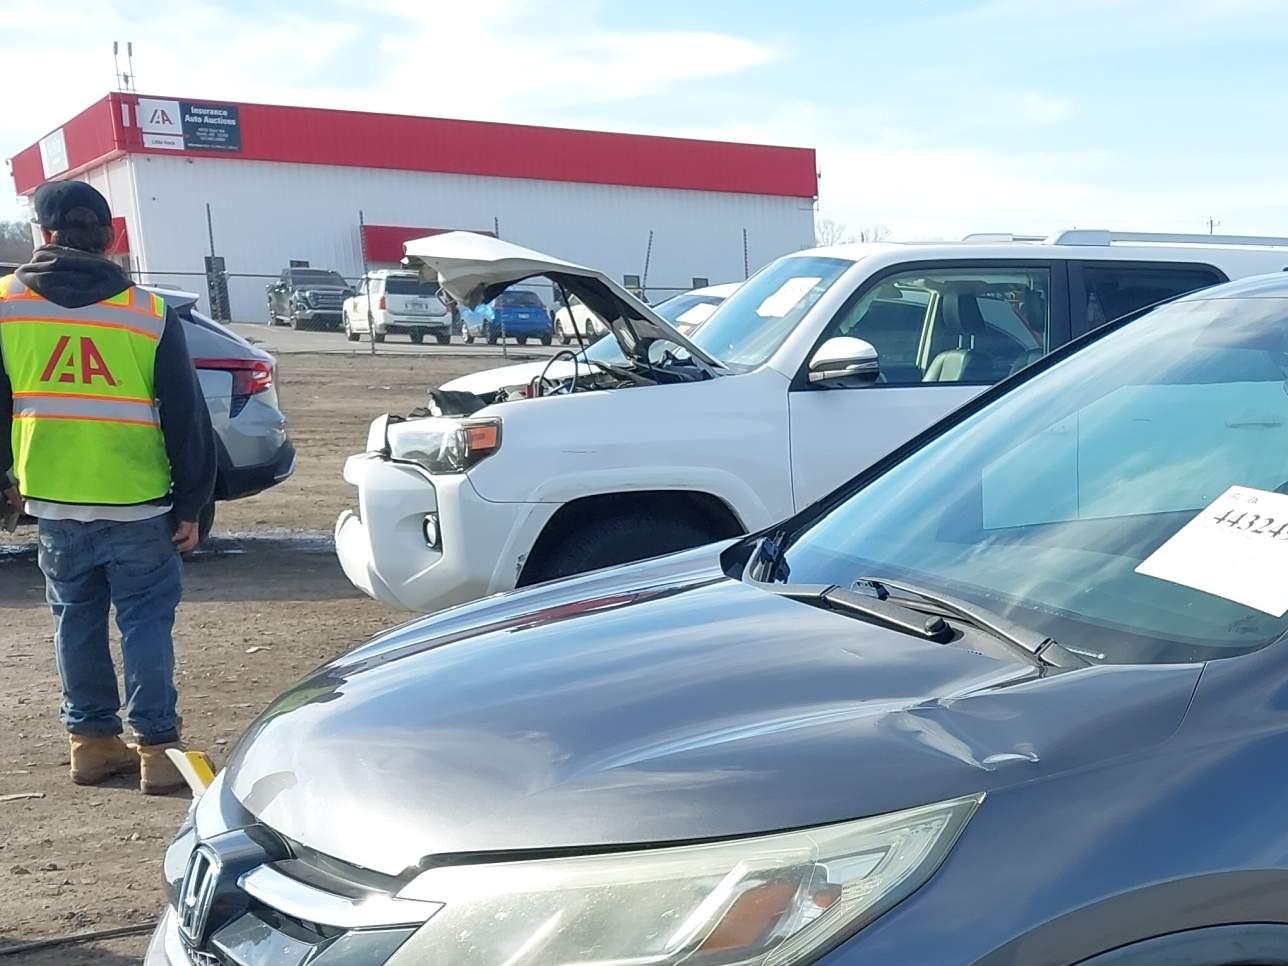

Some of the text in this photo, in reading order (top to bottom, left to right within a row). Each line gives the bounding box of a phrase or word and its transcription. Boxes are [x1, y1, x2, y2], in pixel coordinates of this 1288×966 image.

[191, 106, 228, 116] Insurance
[184, 114, 237, 126] Auto Auctions
